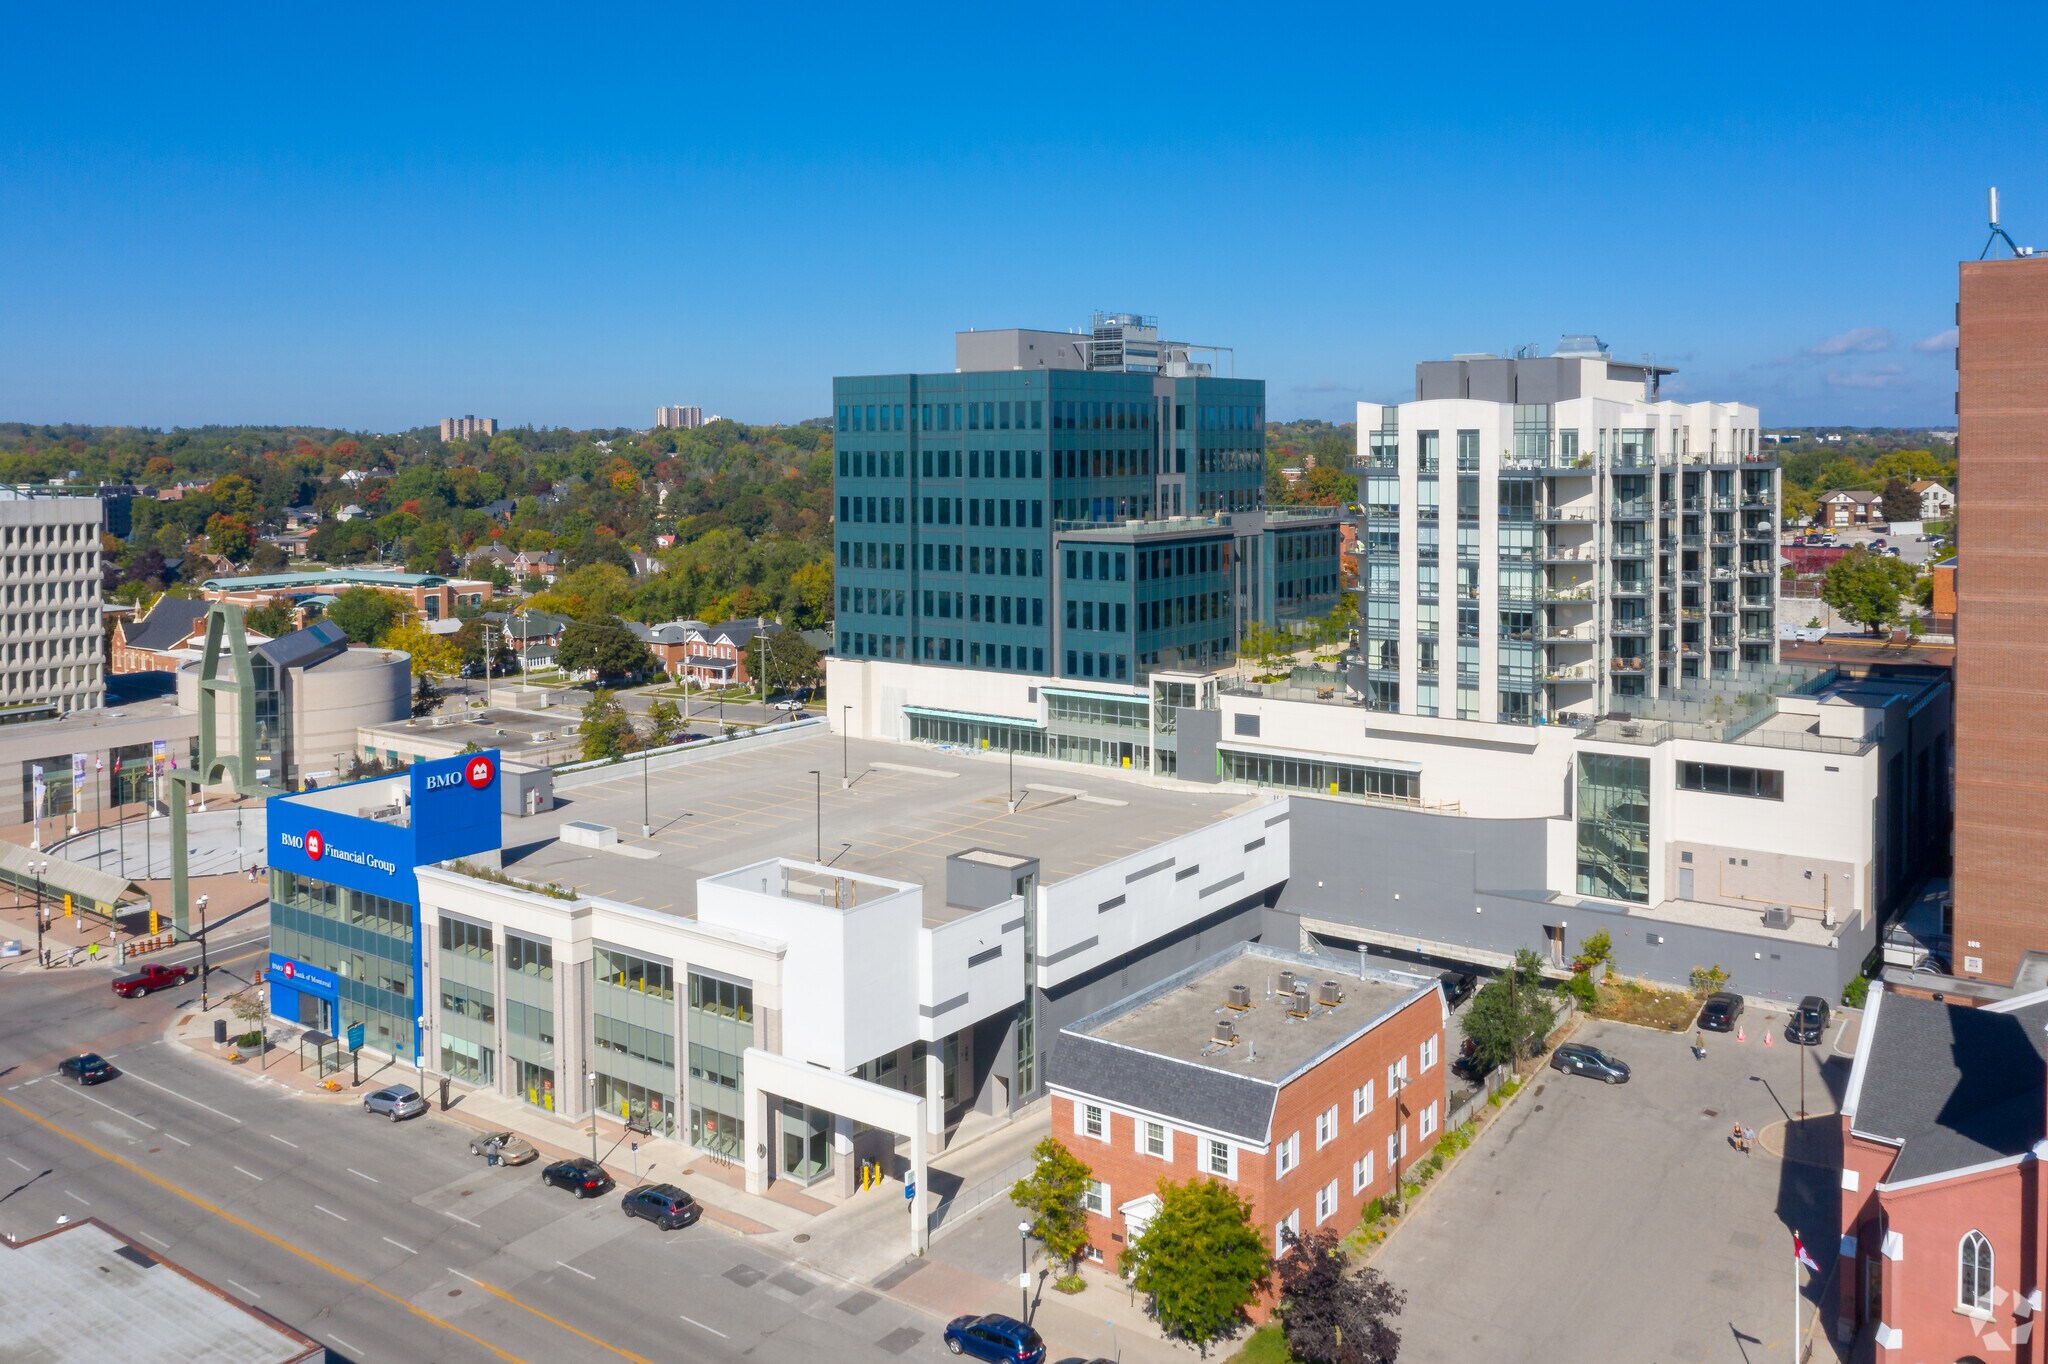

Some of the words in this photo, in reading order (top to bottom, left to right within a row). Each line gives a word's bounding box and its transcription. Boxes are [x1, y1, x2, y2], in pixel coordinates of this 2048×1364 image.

[426, 771, 462, 790] BMO
[281, 832, 304, 849] BMO
[324, 843, 366, 865] Financial
[366, 853, 396, 876] Group
